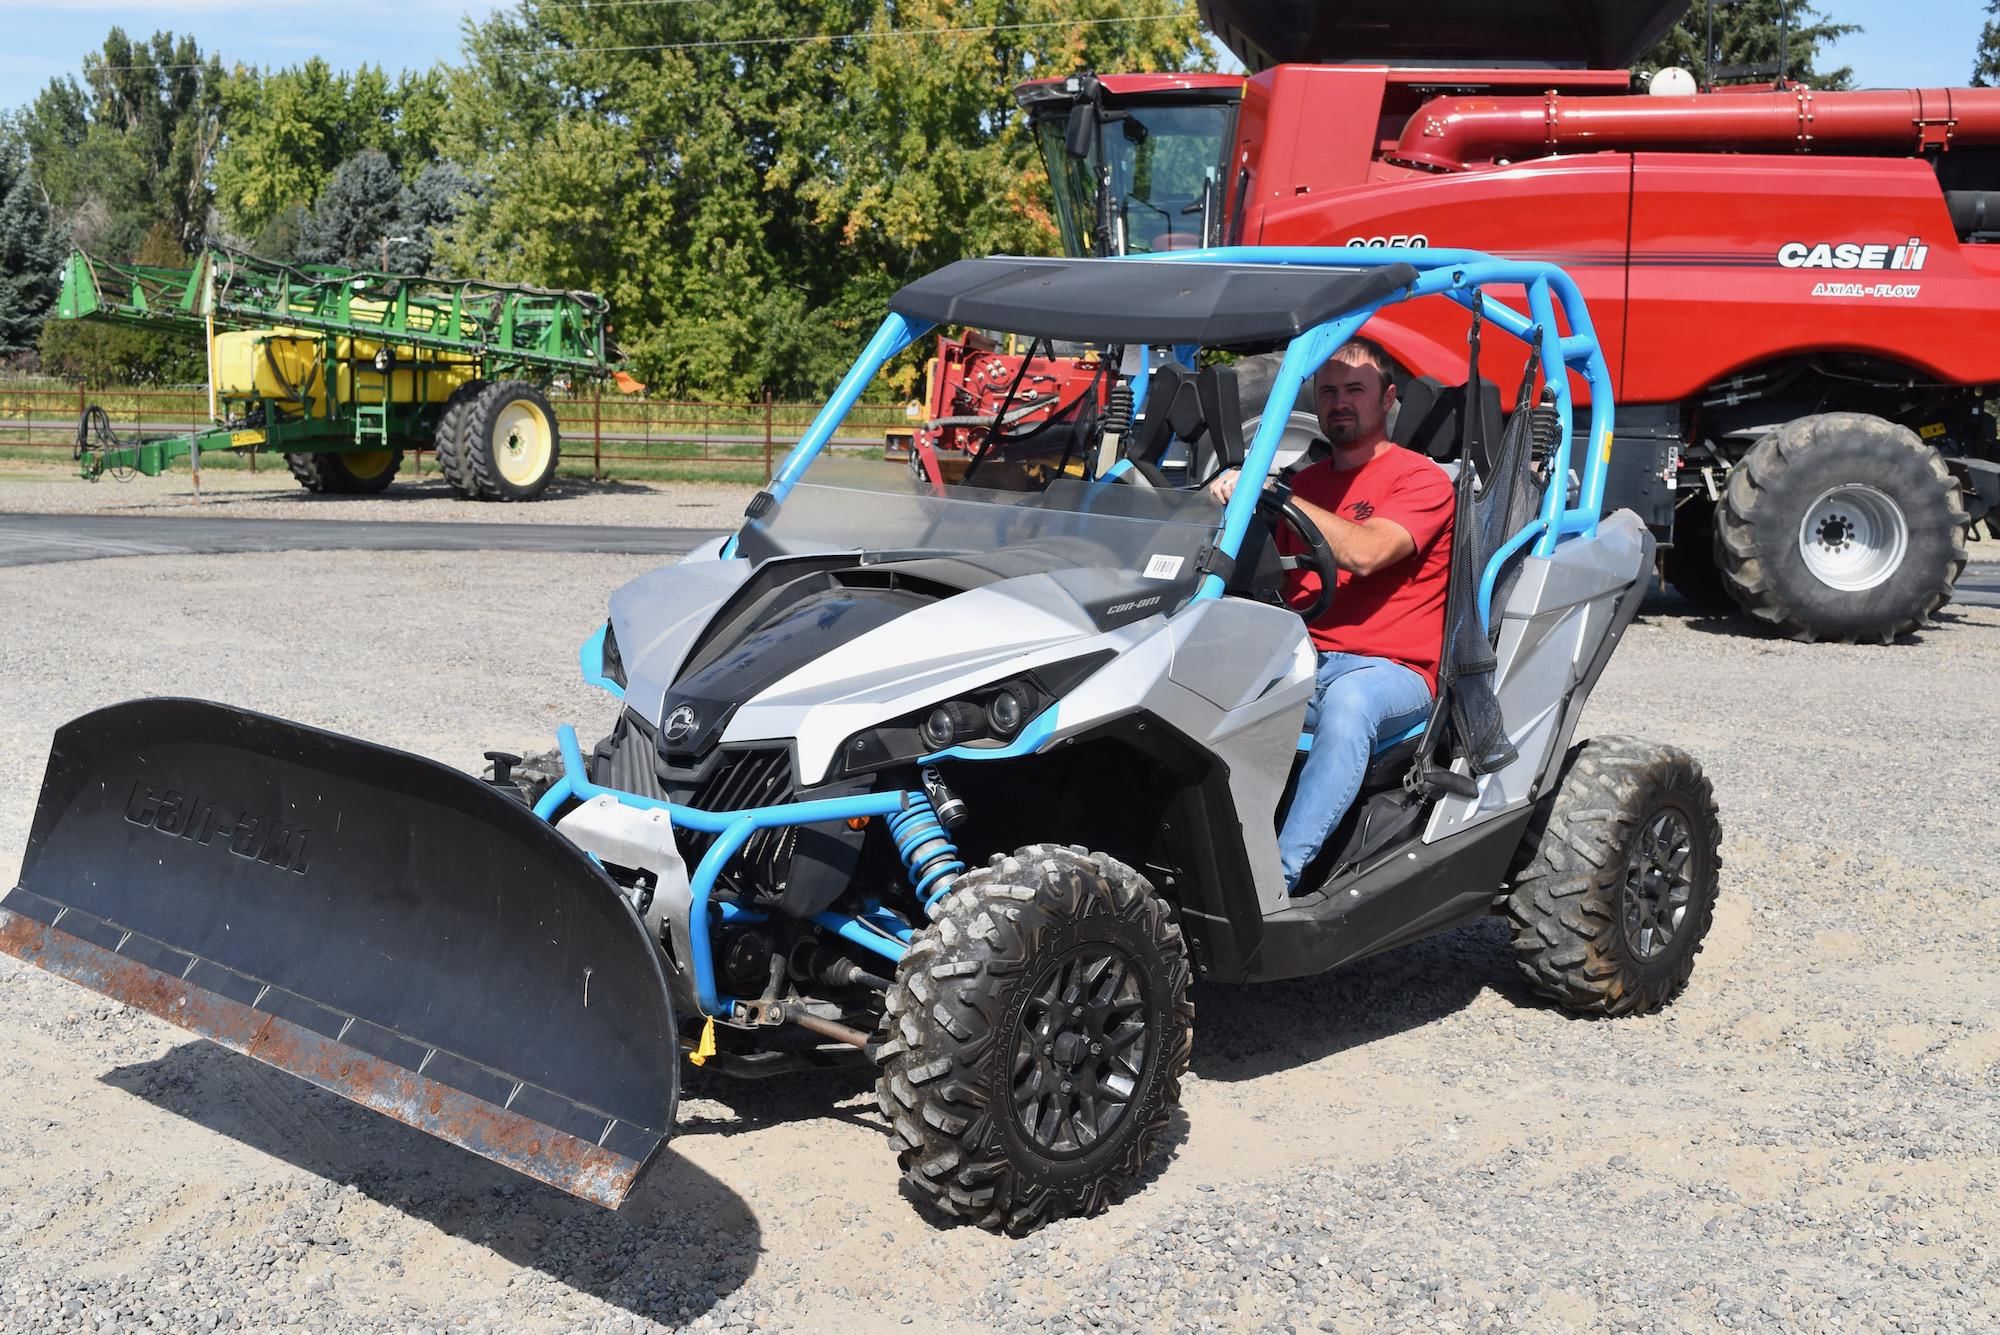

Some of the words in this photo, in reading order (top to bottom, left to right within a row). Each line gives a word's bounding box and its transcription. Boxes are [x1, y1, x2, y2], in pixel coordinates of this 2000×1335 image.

[1777, 242, 1889, 269] CASE
[1811, 283, 1920, 297] AXIAL-FLOW
[1106, 595, 1161, 615] can-am
[124, 780, 312, 876] can-am
